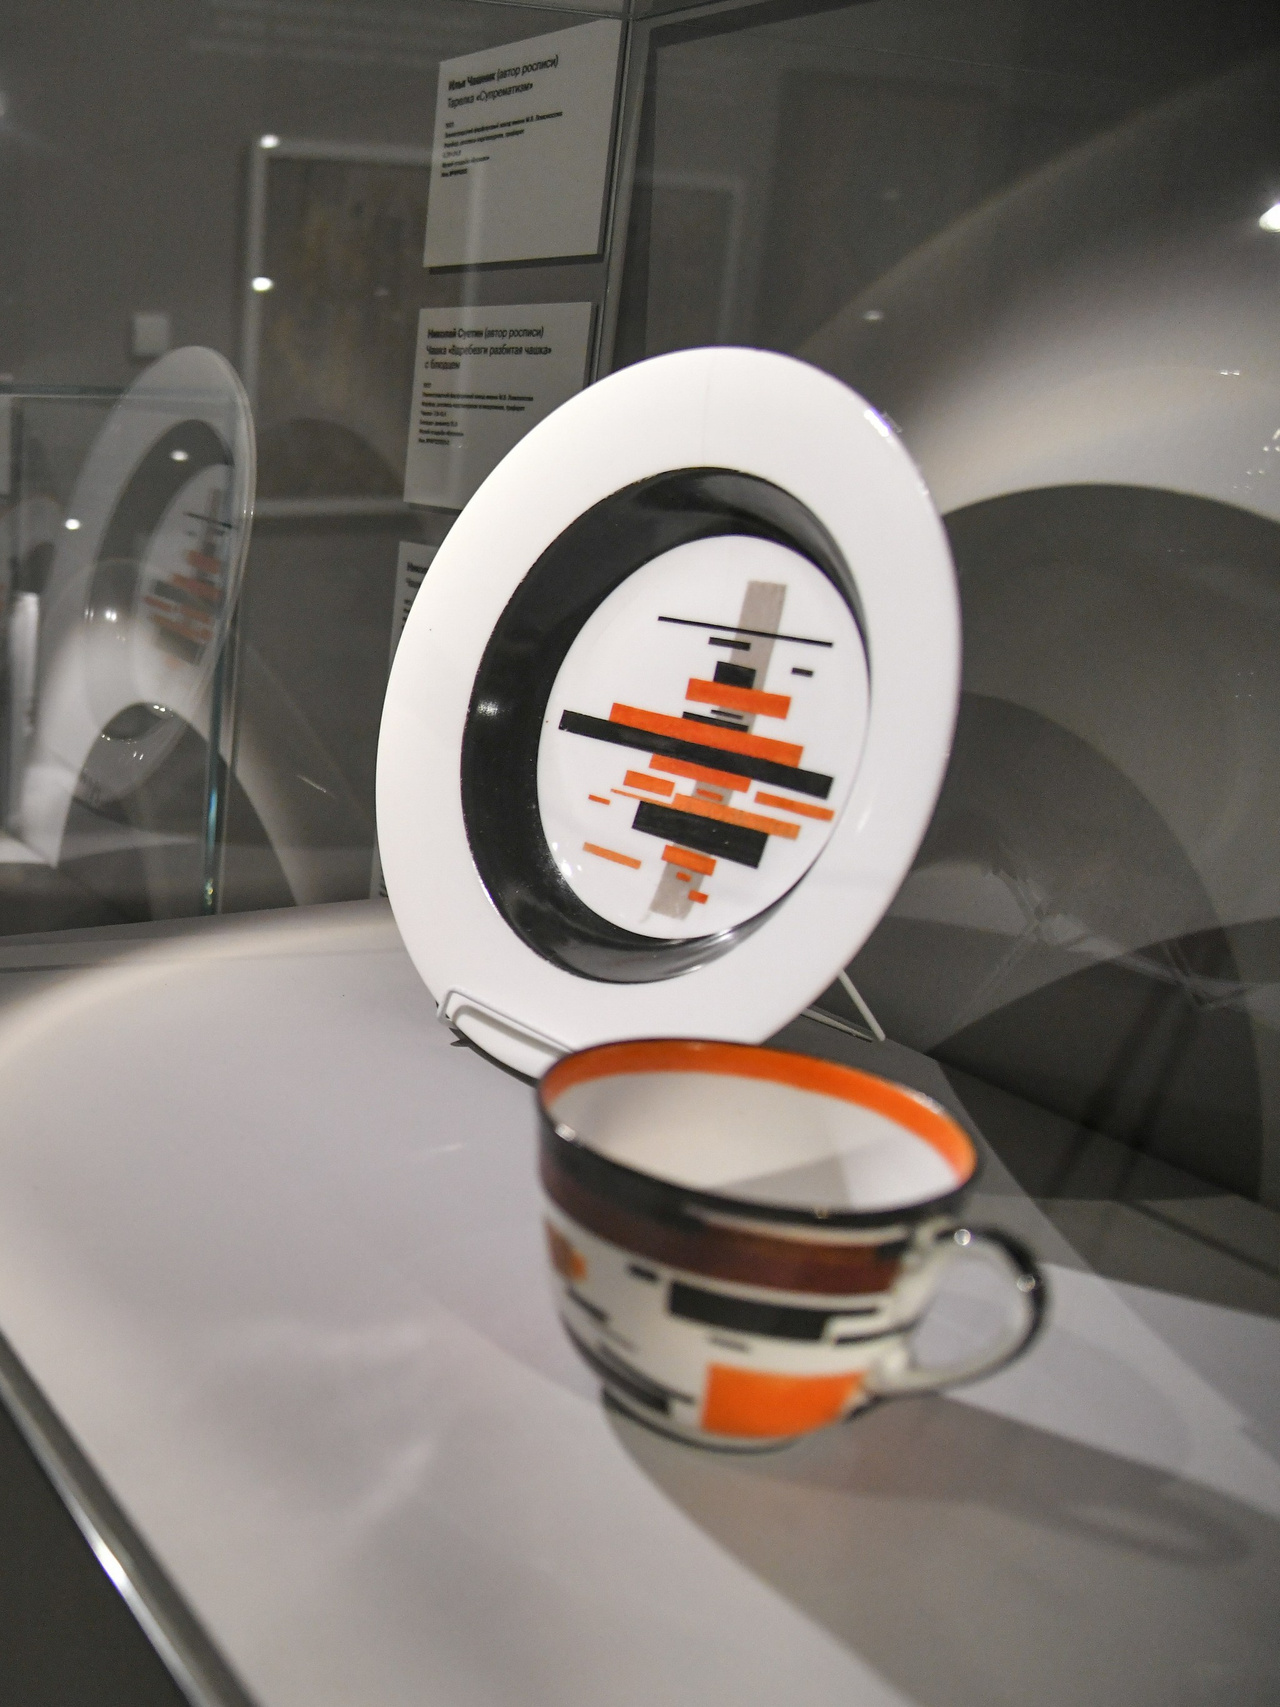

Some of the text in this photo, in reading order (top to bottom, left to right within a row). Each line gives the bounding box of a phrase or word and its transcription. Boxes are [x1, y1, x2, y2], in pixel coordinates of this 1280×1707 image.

[497, 66, 521, 81] (автор
[521, 54, 559, 76] росписи)
[447, 82, 533, 109] Тарелка «Супрематизм»
[457, 328, 483, 339] Суетин
[484, 326, 508, 340] (автор
[508, 326, 544, 339] росписи)
[489, 343, 523, 357] разбитая
[524, 346, 552, 355] чашка»
